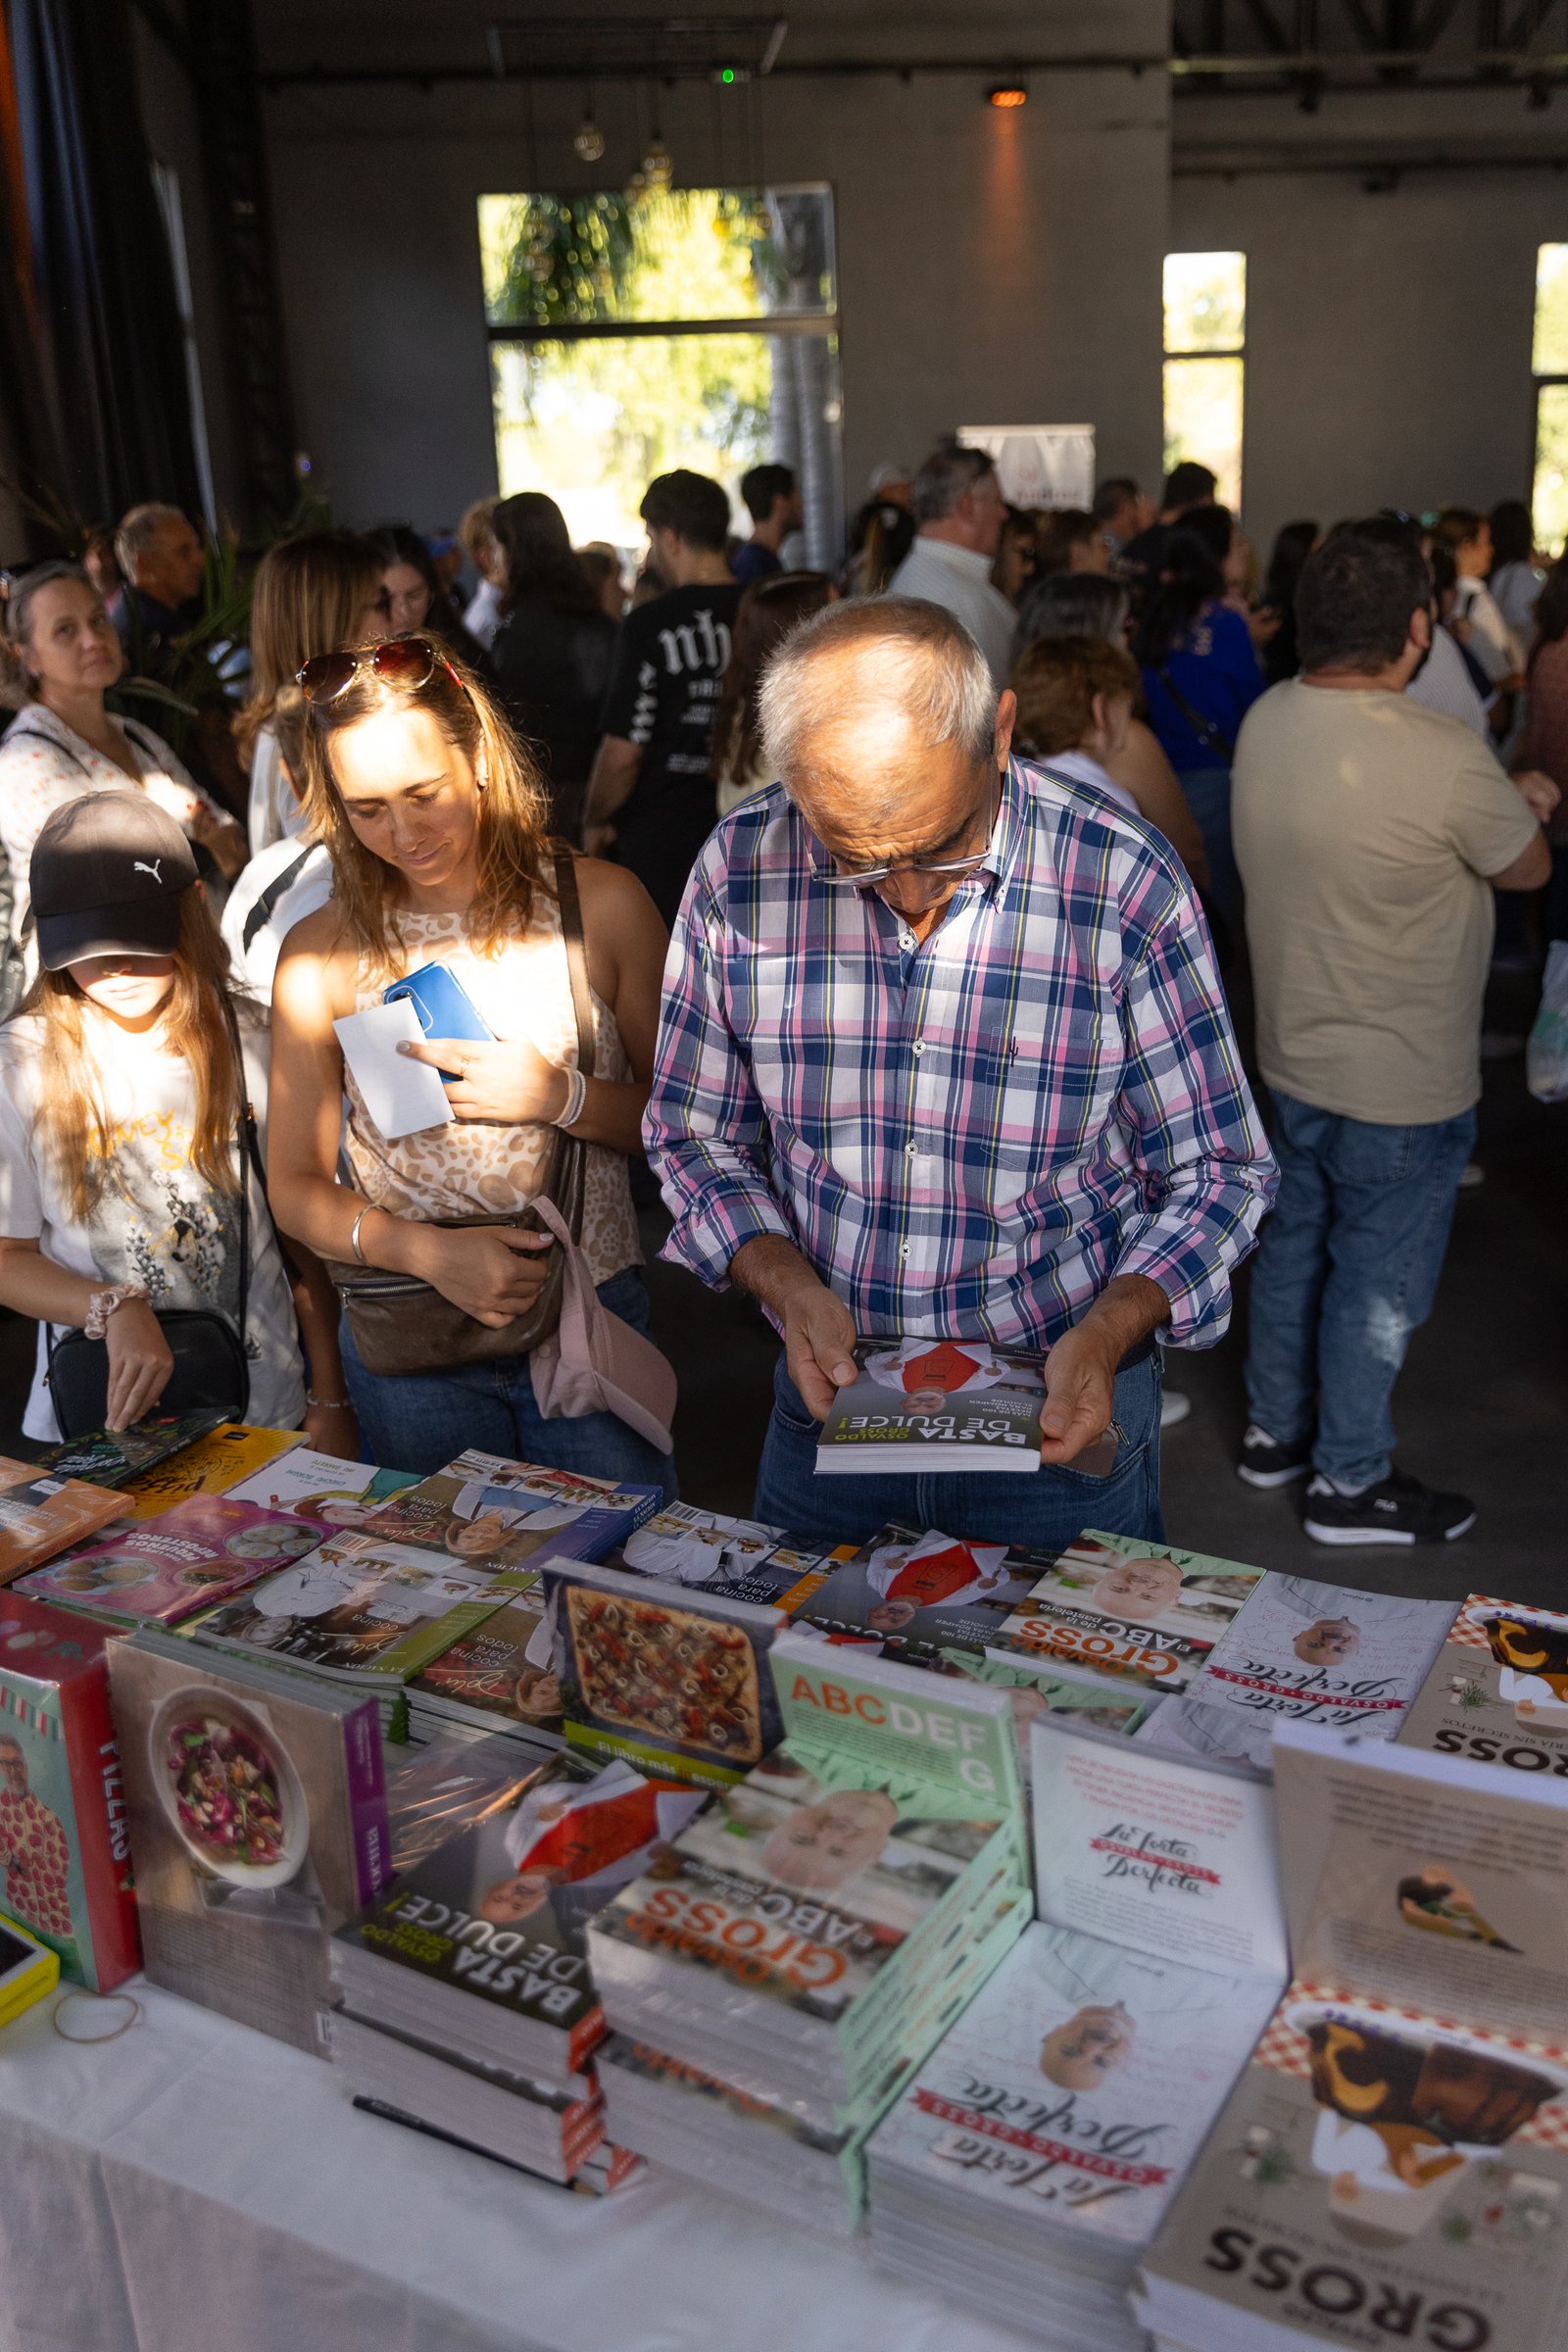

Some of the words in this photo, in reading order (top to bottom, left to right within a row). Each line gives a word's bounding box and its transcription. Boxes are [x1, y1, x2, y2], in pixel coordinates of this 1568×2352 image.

[839, 1416, 956, 1429] DULCE!
[966, 1417, 1010, 1431] DE
[834, 1432, 908, 1441] OSVALDO
[917, 1427, 1027, 1445] BASTA
[409, 1504, 440, 1514] para
[410, 1495, 447, 1508] todos
[387, 1505, 430, 1520] cocina
[125, 1533, 219, 1558] REPOSTEROS
[738, 1584, 772, 1597] para
[739, 1575, 778, 1590] todos
[715, 1586, 762, 1603] cocina
[1039, 1602, 1102, 1624] pastelería
[1066, 1616, 1079, 1625] la
[352, 1613, 399, 1631] cocina
[935, 1619, 971, 1631] ROMPER
[957, 1618, 989, 1629] MOLDE
[1081, 1619, 1097, 1629] de
[476, 1634, 518, 1652] todos
[956, 1629, 991, 1641] RECETAS
[1099, 1622, 1181, 1650] ABC
[475, 1645, 510, 1660] para
[1177, 1643, 1192, 1652] El
[450, 1647, 500, 1668] cocina
[1225, 1673, 1285, 1693] GROSS
[1301, 1692, 1388, 1708] OSVALDO
[1442, 1718, 1510, 1740] SECRETOS
[1514, 1735, 1537, 1744] SIN
[598, 1740, 612, 1753] El
[613, 1746, 646, 1765] libro
[648, 1757, 676, 1775] más
[382, 1890, 526, 1959] DULCE!
[754, 1891, 862, 1942] ABC
[359, 1923, 441, 1963] OSVALDO
[394, 1921, 454, 1953] GROSS
[521, 1942, 585, 1982] DE
[452, 1945, 582, 2017] BASTA
[1201, 2228, 1491, 2352] GROSS
